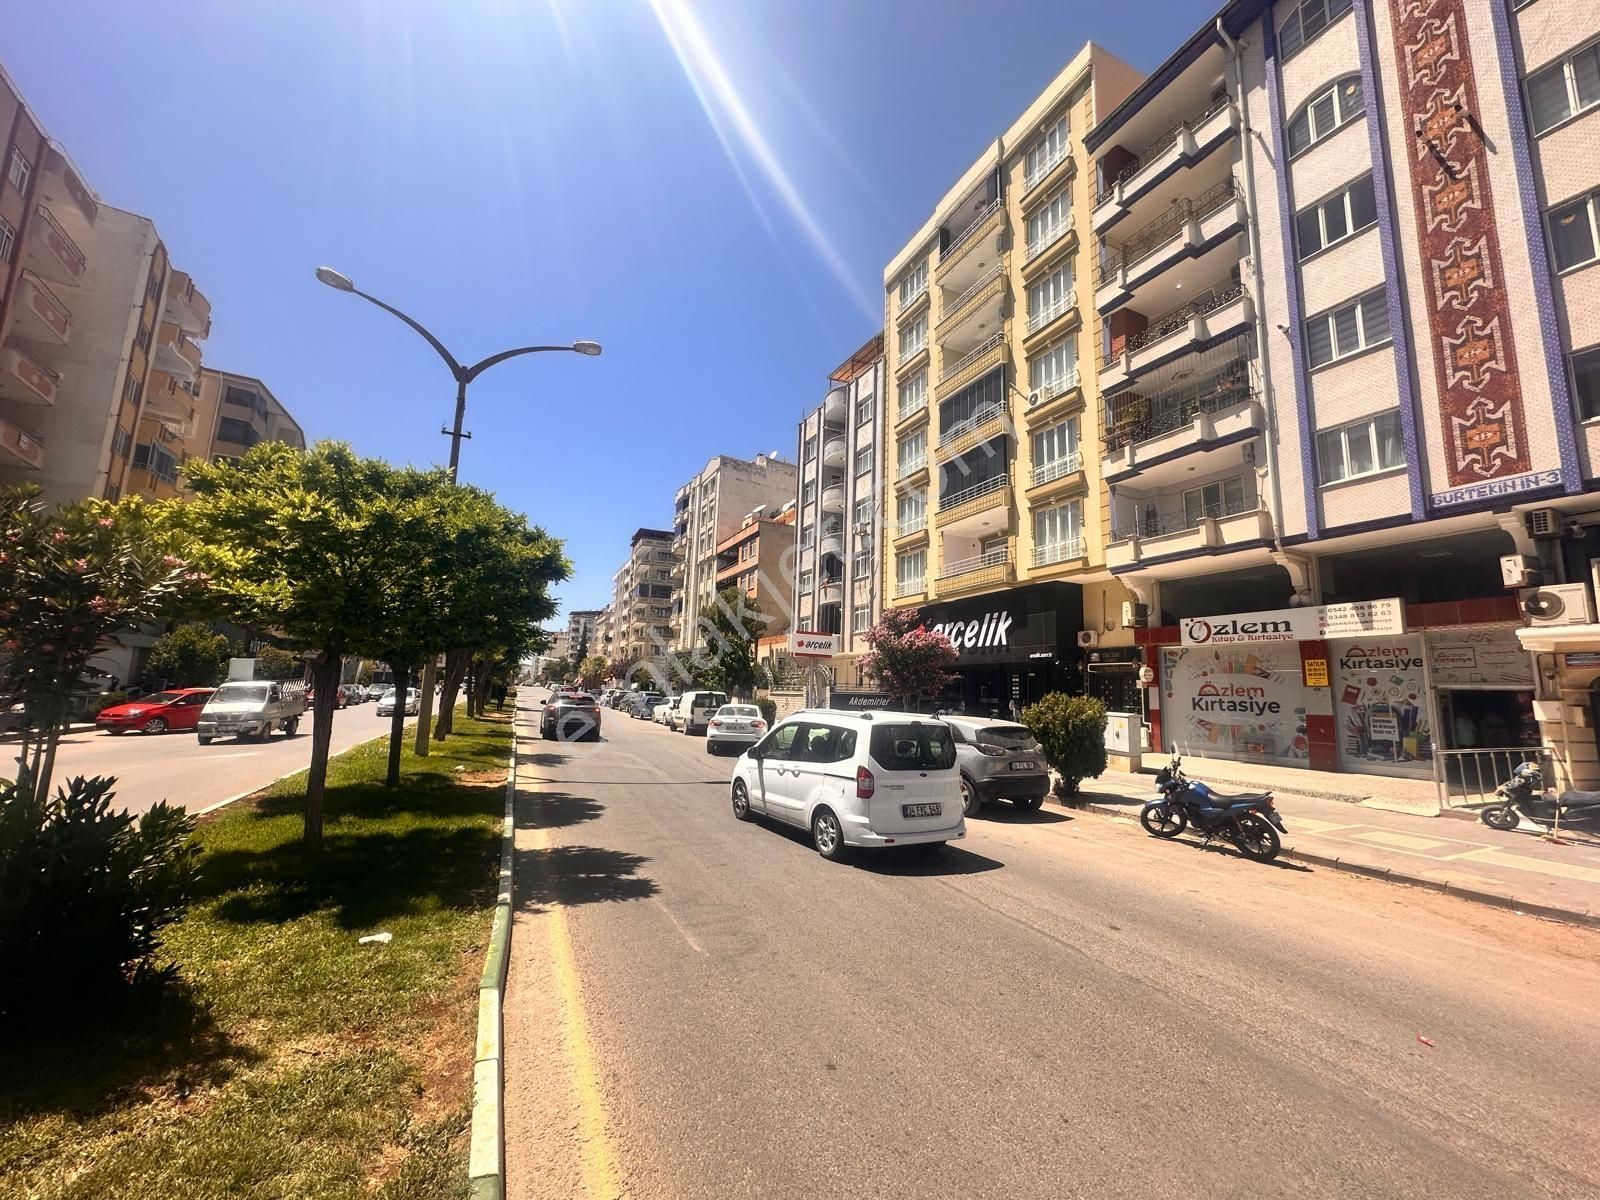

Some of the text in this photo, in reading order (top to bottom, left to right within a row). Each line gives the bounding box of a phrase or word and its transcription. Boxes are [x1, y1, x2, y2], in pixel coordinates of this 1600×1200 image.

[1185, 618, 1293, 643] Özlem
[805, 640, 832, 650] arçelik
[1345, 645, 1409, 657] Özlem
[1340, 655, 1424, 671] Kırtasiye
[1198, 681, 1265, 697] Özlem
[848, 697, 890, 706] Akdemirler
[1192, 696, 1281, 717] Kırtasiye
